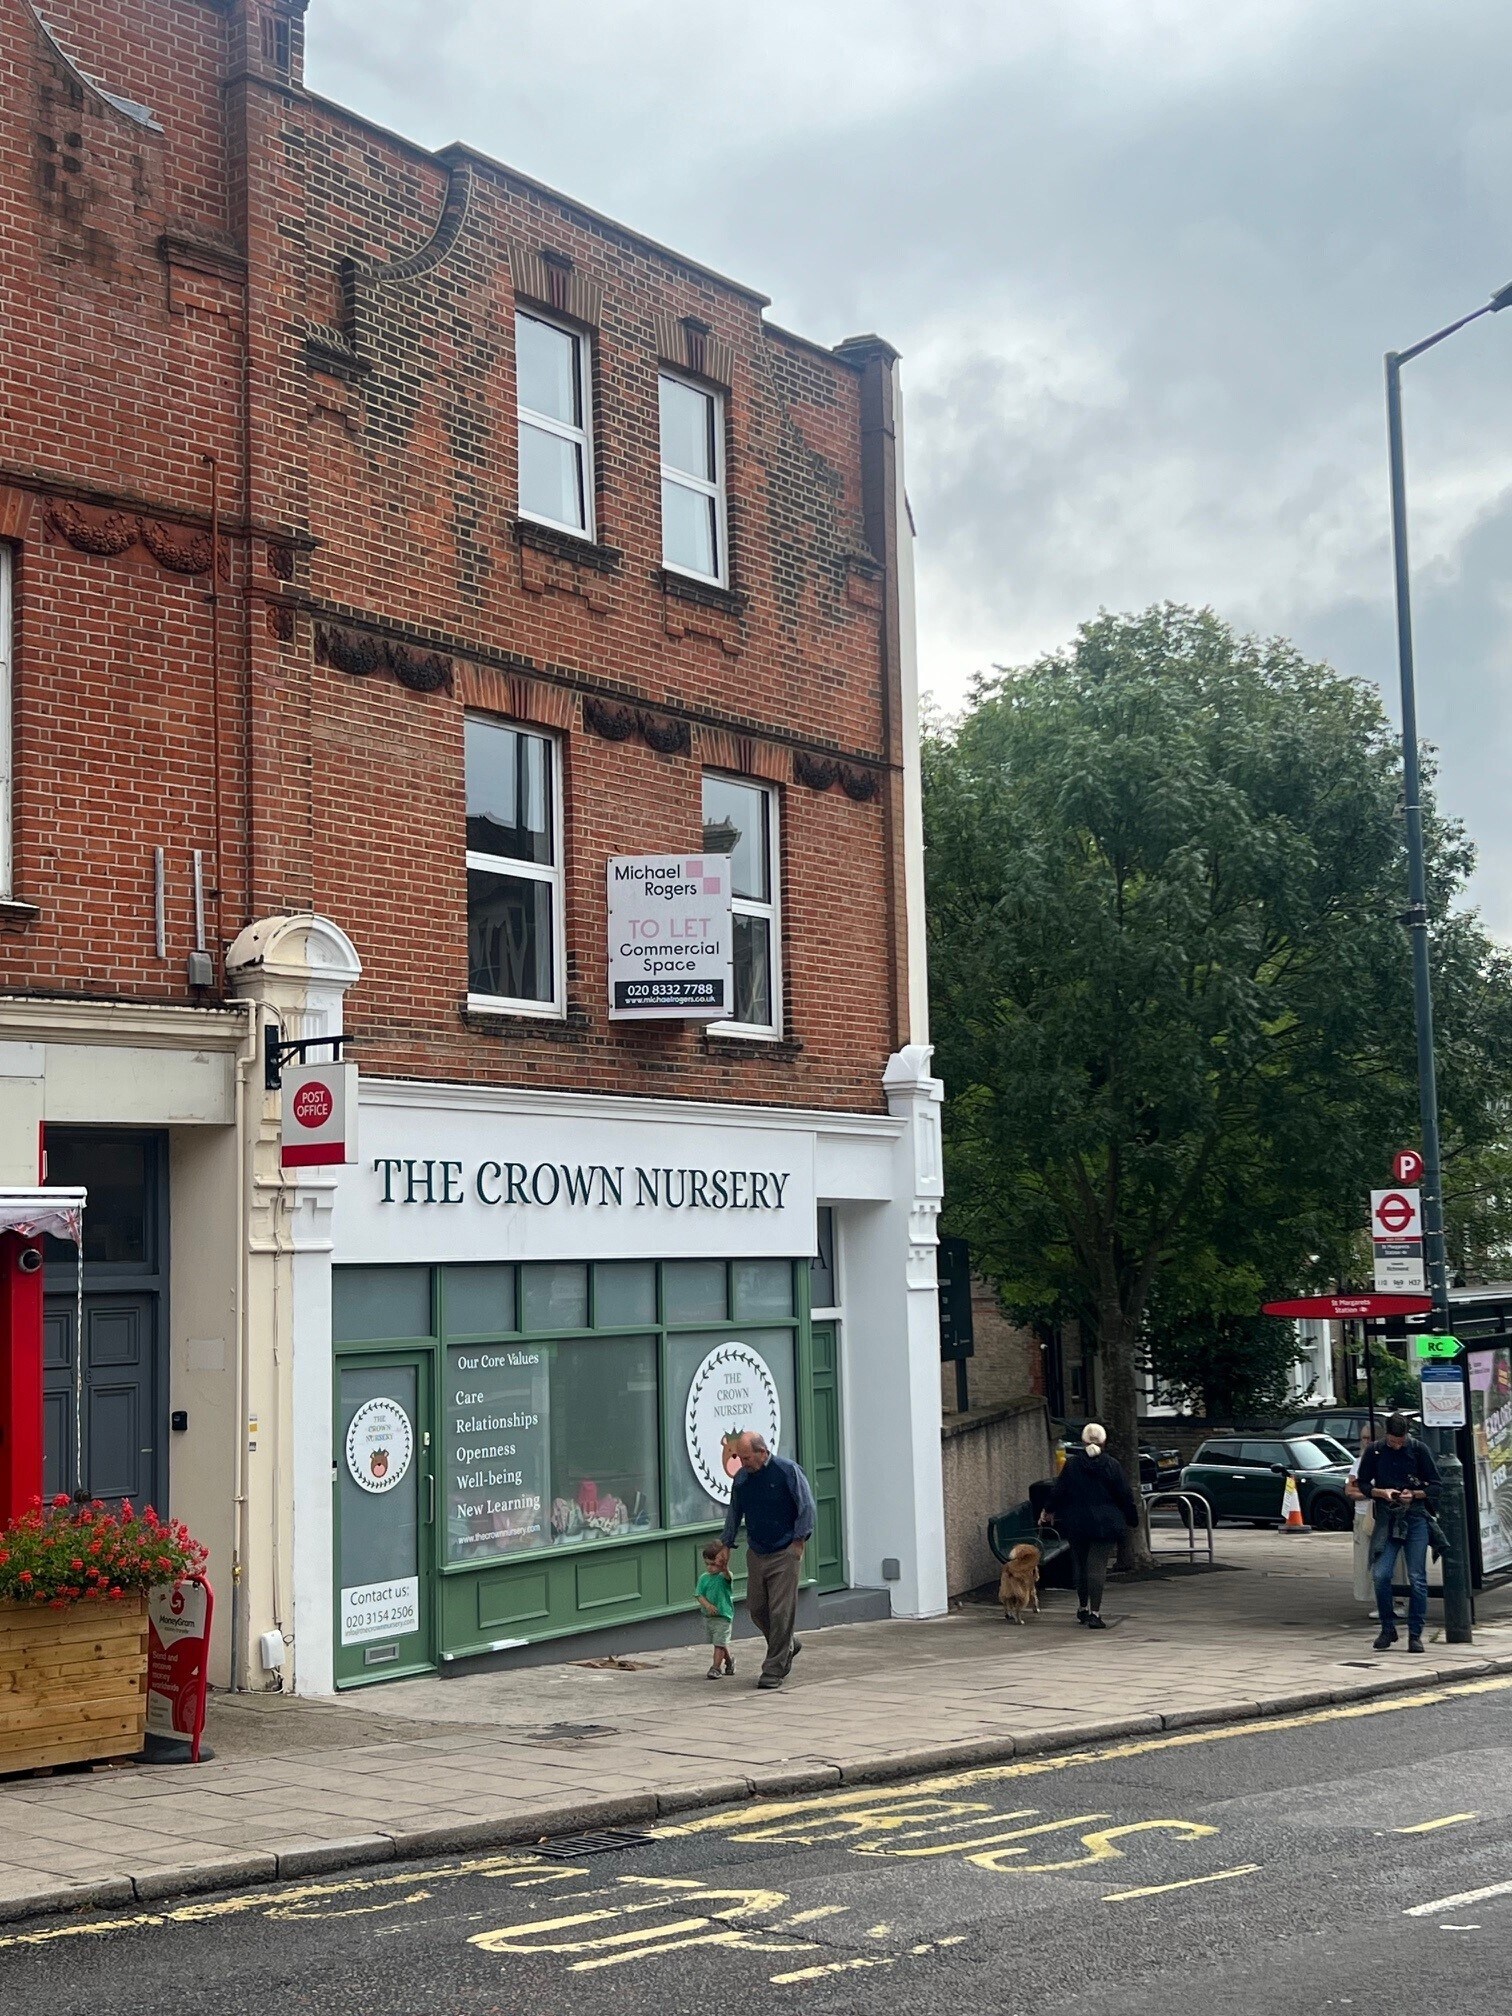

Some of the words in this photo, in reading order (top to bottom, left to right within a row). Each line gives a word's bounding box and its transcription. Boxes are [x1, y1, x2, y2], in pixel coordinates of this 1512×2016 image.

[615, 864, 681, 880] Michael
[645, 882, 697, 900] Rogers
[628, 919, 660, 939] TO
[670, 918, 711, 938] LET
[620, 941, 720, 957] Commercial
[643, 958, 696, 976] Space
[627, 984, 650, 996] 020
[652, 984, 681, 996] 8332
[684, 983, 713, 995] 7788
[624, 996, 716, 1006] www.michaelrogers.co.uk
[301, 1091, 325, 1104] POST
[296, 1104, 329, 1118] OFFICE
[1400, 1155, 1416, 1180] P
[374, 1158, 464, 1204] THE
[476, 1161, 624, 1206] CROWN
[635, 1167, 791, 1209] NURSERY
[1334, 1306, 1358, 1314] Station
[1427, 1342, 1443, 1352] RC
[457, 1356, 479, 1370] Our
[481, 1354, 505, 1368] Core
[507, 1350, 540, 1366] Values
[724, 1372, 742, 1384] THE
[456, 1390, 484, 1405] Care
[716, 1386, 750, 1401] CROWN
[713, 1402, 754, 1417] NURSERY
[456, 1412, 539, 1434] Relationships
[456, 1443, 516, 1464] Openness
[457, 1468, 523, 1489] Well-being
[457, 1503, 483, 1519] New
[486, 1493, 541, 1514] Learning
[350, 1587, 392, 1606] Contact
[395, 1585, 410, 1598] us:
[159, 1615, 195, 1628] MoneyGram
[346, 1613, 364, 1628] 020
[366, 1609, 389, 1625] 3154
[391, 1604, 414, 1620] 2506
[152, 1651, 166, 1660] Send
[167, 1654, 178, 1662] and
[152, 1672, 170, 1682] money
[151, 1681, 180, 1692] worldwide
[727, 1796, 1222, 1876] BUS
